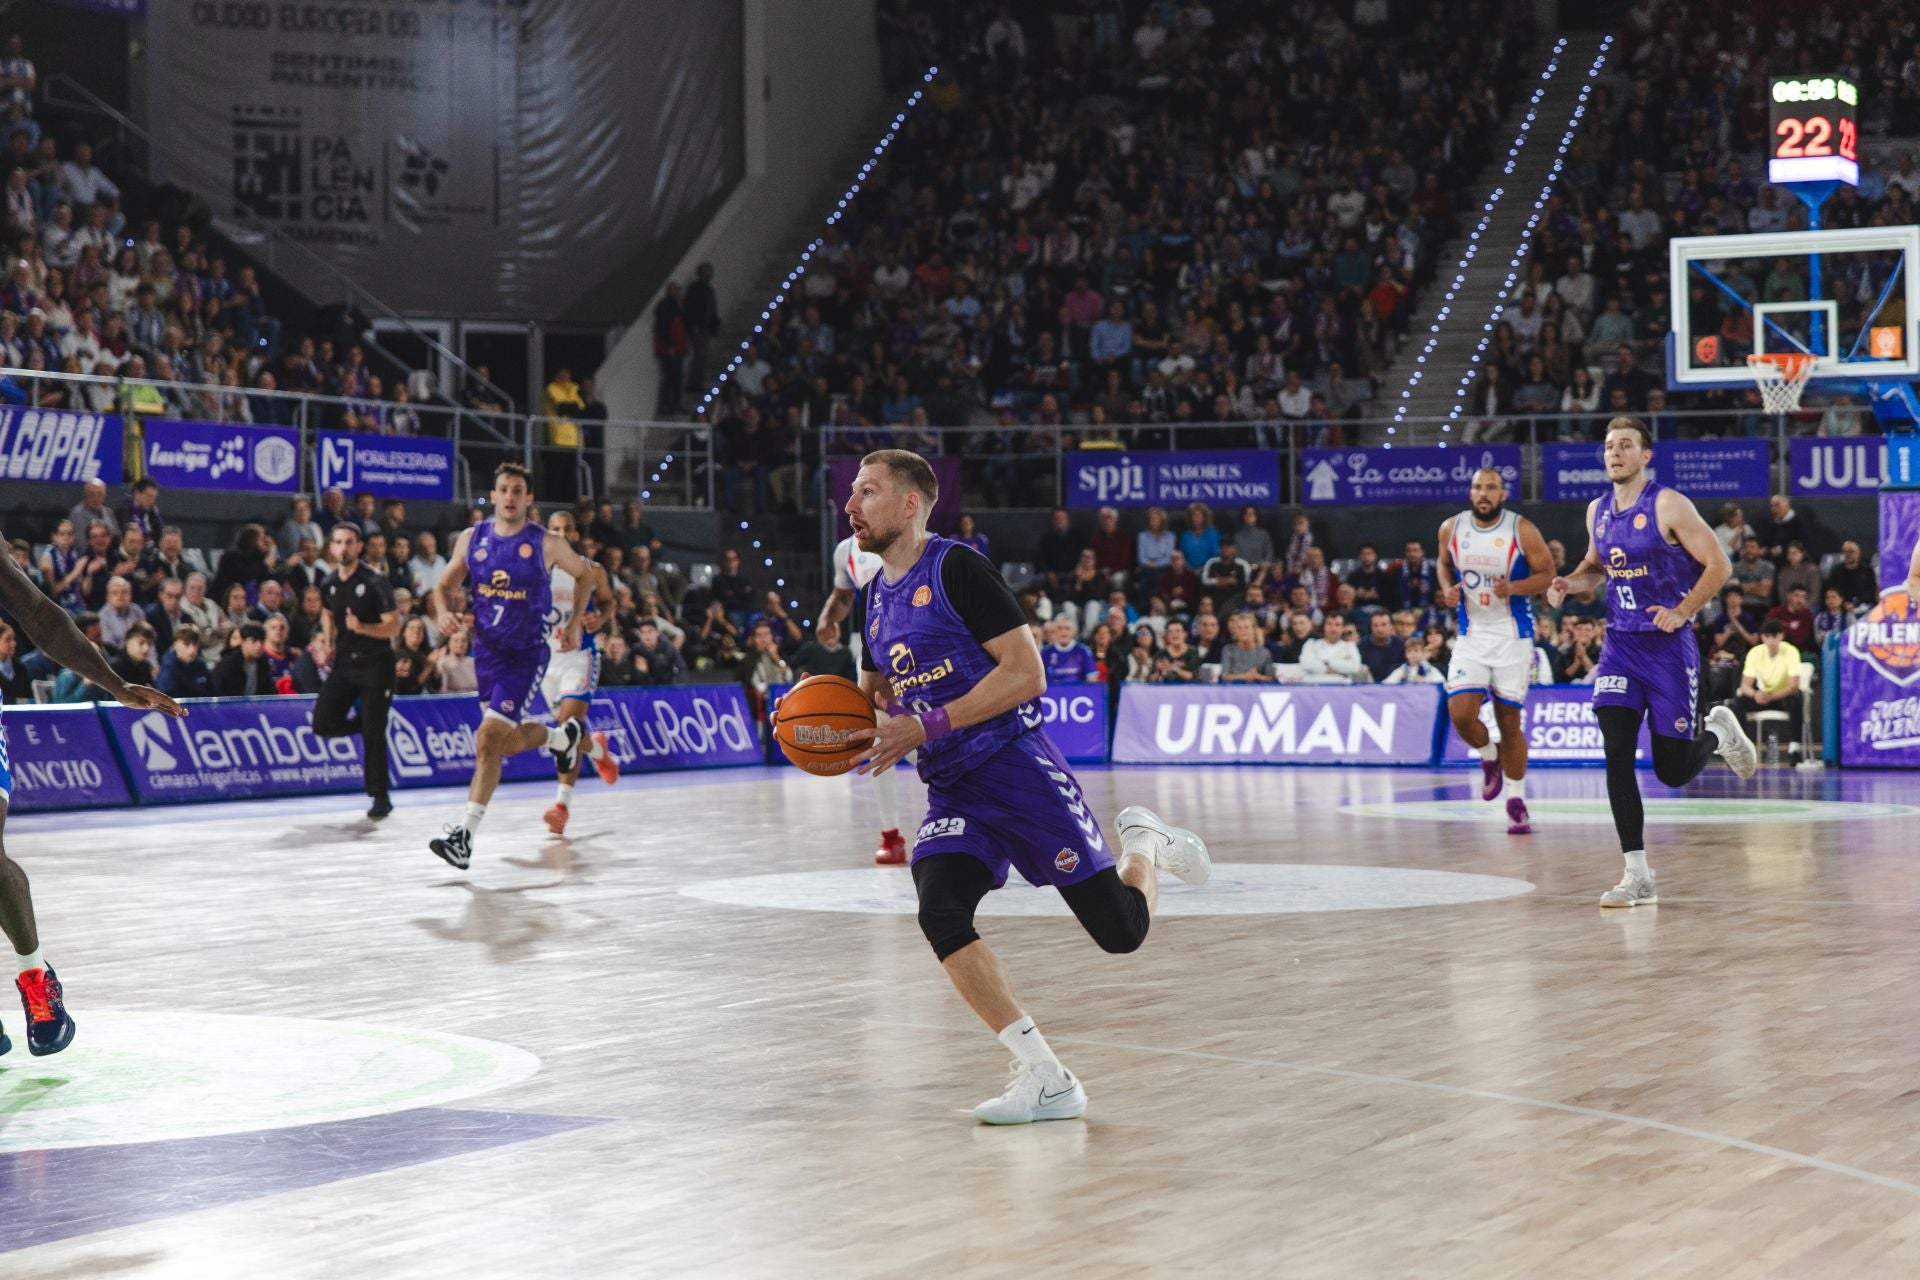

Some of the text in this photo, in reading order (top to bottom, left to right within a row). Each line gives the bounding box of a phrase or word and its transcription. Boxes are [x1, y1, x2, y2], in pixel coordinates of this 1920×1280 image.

[193, 2, 271, 30] CIUDAD
[279, 4, 381, 36] EUROPEA
[311, 136, 351, 162] PA
[1776, 116, 1833, 158] 22
[311, 165, 374, 192] LEN
[311, 195, 368, 221] CIA
[0, 409, 105, 481] LCOPAL
[1159, 464, 1241, 481] SABORES
[1347, 453, 1384, 484] La
[1387, 464, 1447, 484] casa
[1159, 483, 1269, 499] PALENTINOS
[1616, 585, 1637, 609] 13
[492, 604, 504, 627] 7
[1856, 622, 1920, 647] PALEN
[1532, 702, 1597, 724] HERR
[1870, 696, 1920, 720] JUEG
[1154, 692, 1397, 755] URMAN
[1860, 717, 1920, 744] PALEN
[175, 714, 358, 770] lambda
[10, 759, 102, 790] ANCHO
[915, 817, 966, 847] aza
